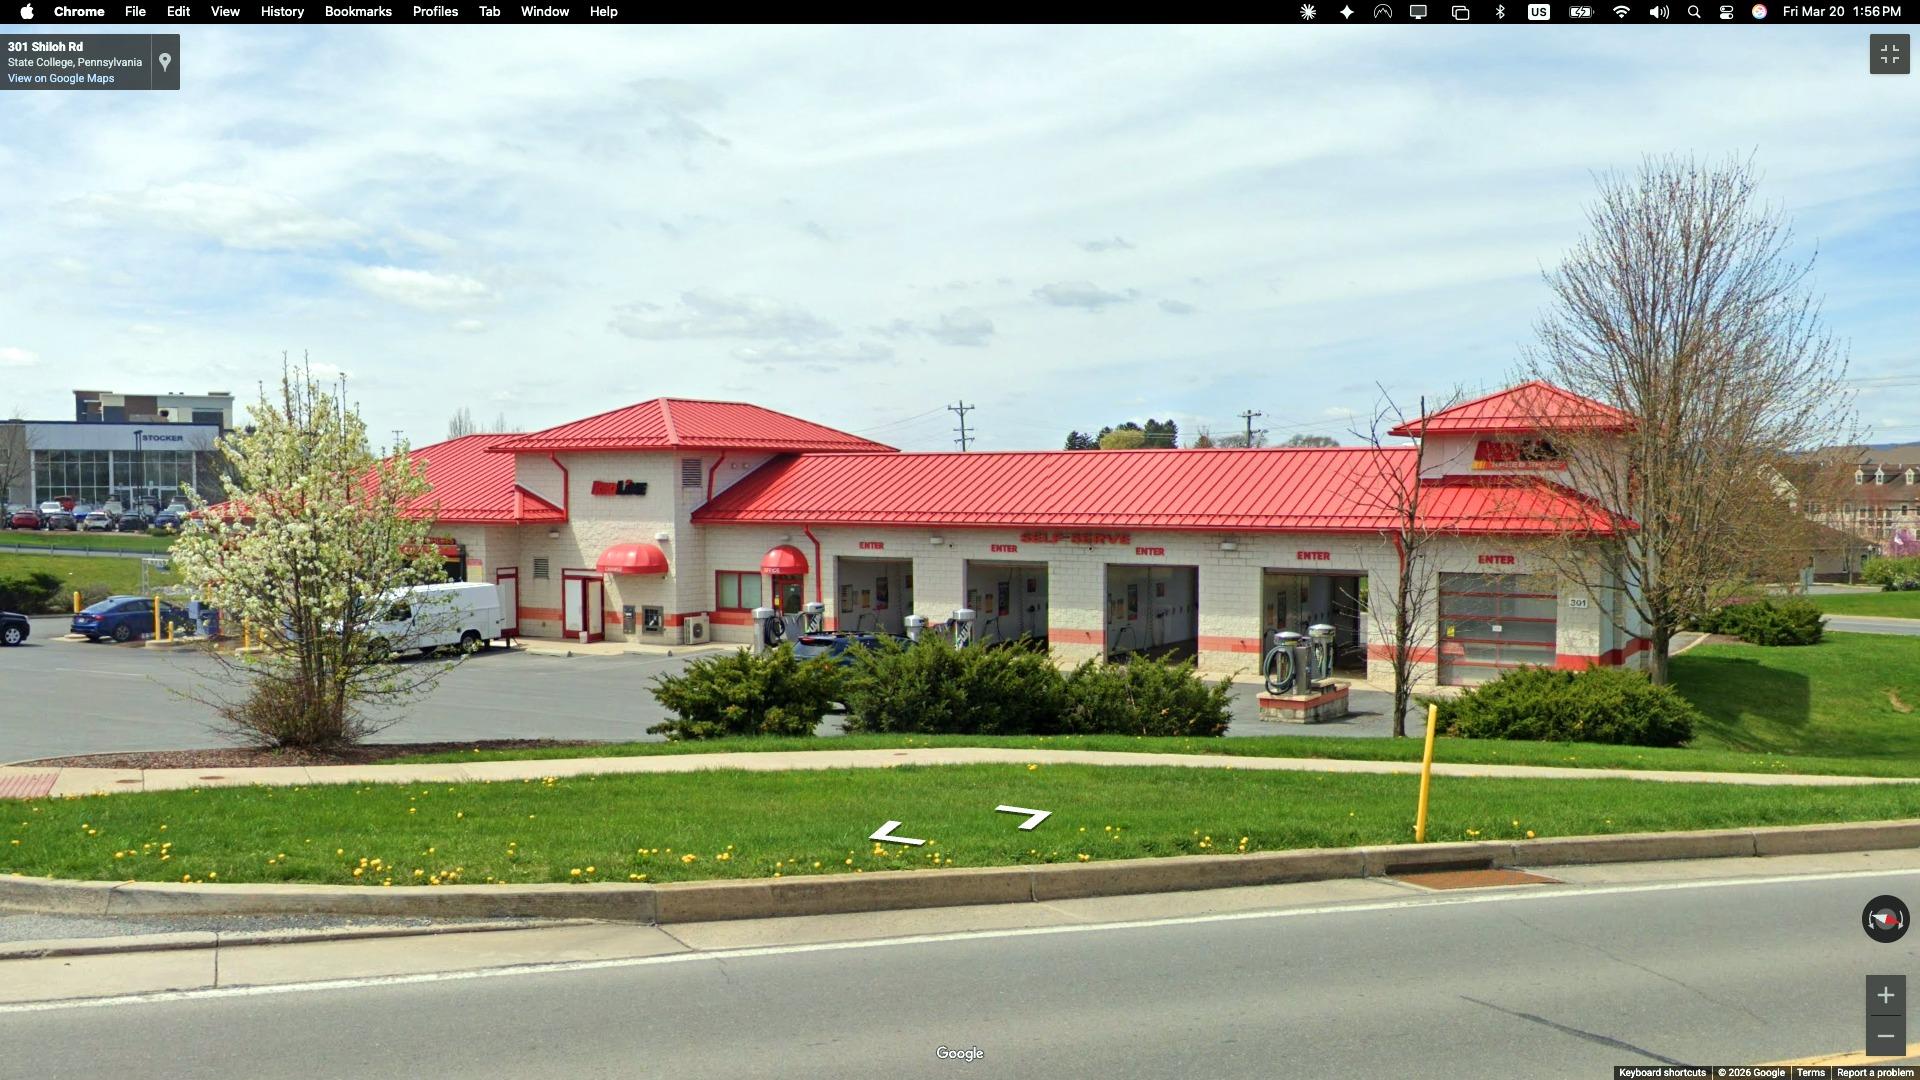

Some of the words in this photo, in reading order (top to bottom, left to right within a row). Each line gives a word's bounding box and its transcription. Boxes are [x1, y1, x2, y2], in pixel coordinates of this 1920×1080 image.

[142, 434, 184, 442] STOCKER
[1021, 532, 1131, 545] SELF-SERVE
[859, 541, 884, 550] ENTER
[991, 544, 1018, 553] ENTER
[1135, 547, 1165, 556] ENTER
[1297, 551, 1331, 561] ENTER
[1478, 555, 1515, 565] ENTER
